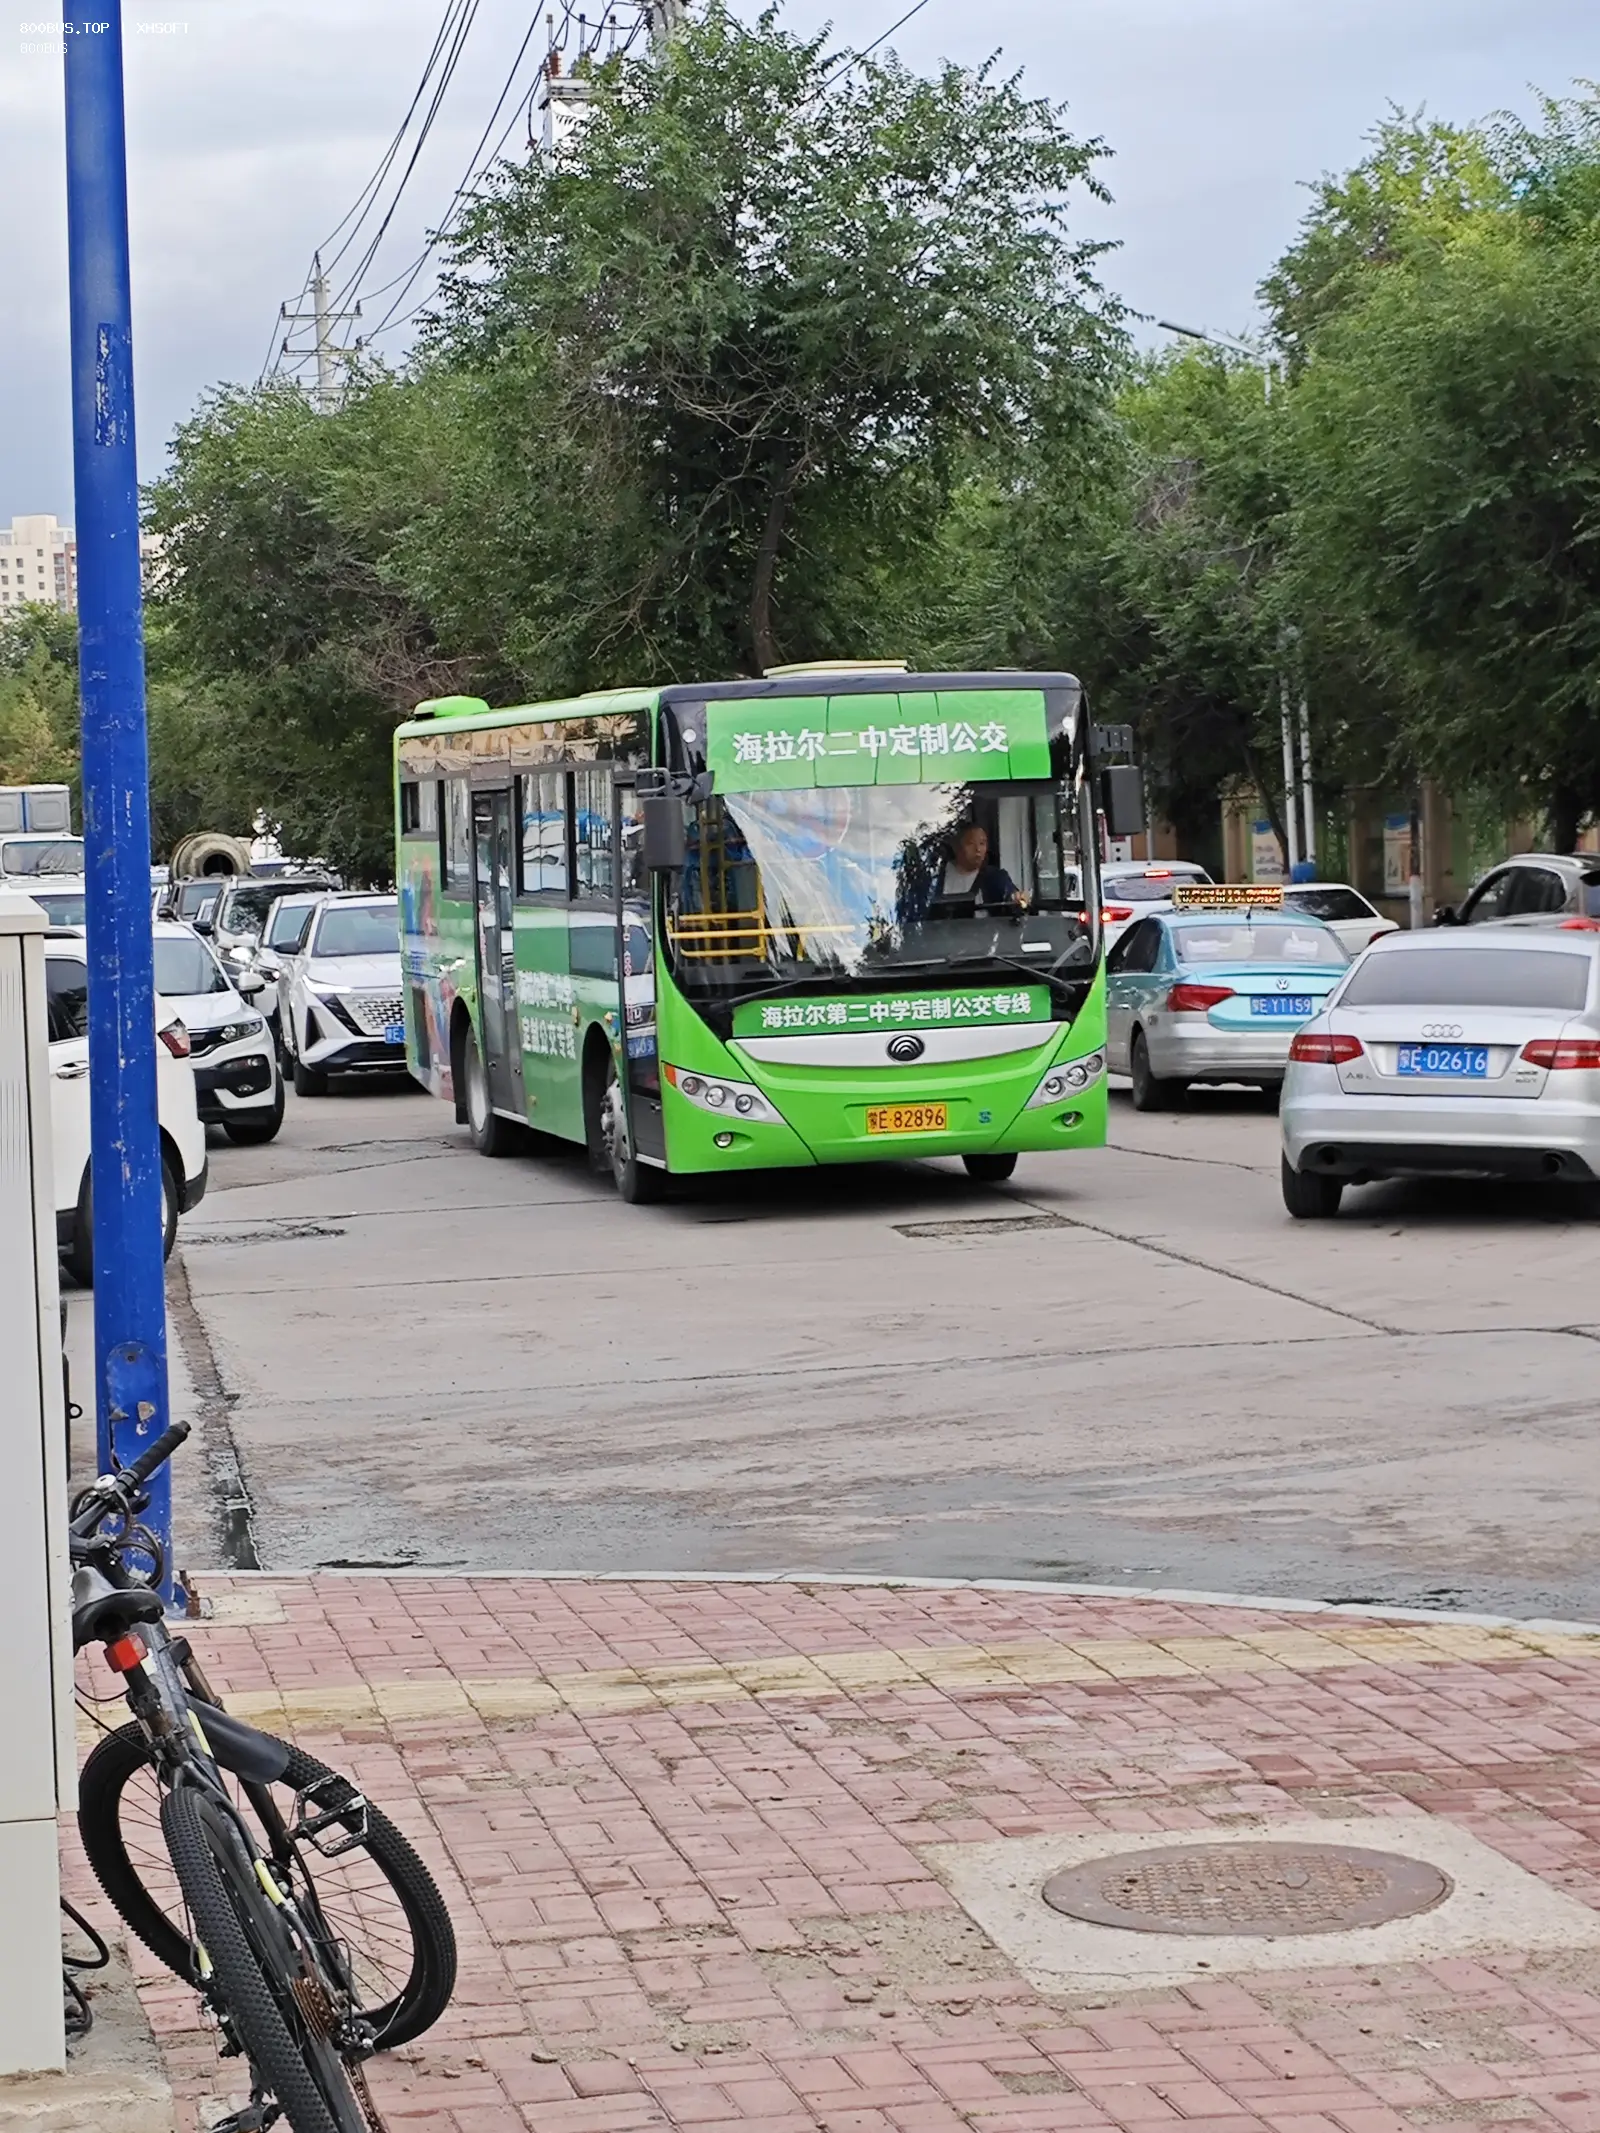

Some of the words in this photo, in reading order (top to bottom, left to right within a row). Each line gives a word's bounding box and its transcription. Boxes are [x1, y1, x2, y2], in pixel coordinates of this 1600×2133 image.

[732, 721, 1010, 765] 海拉尔二中定制公交
[761, 993, 1031, 1029] 海拉尔第二中学定制公交专线
